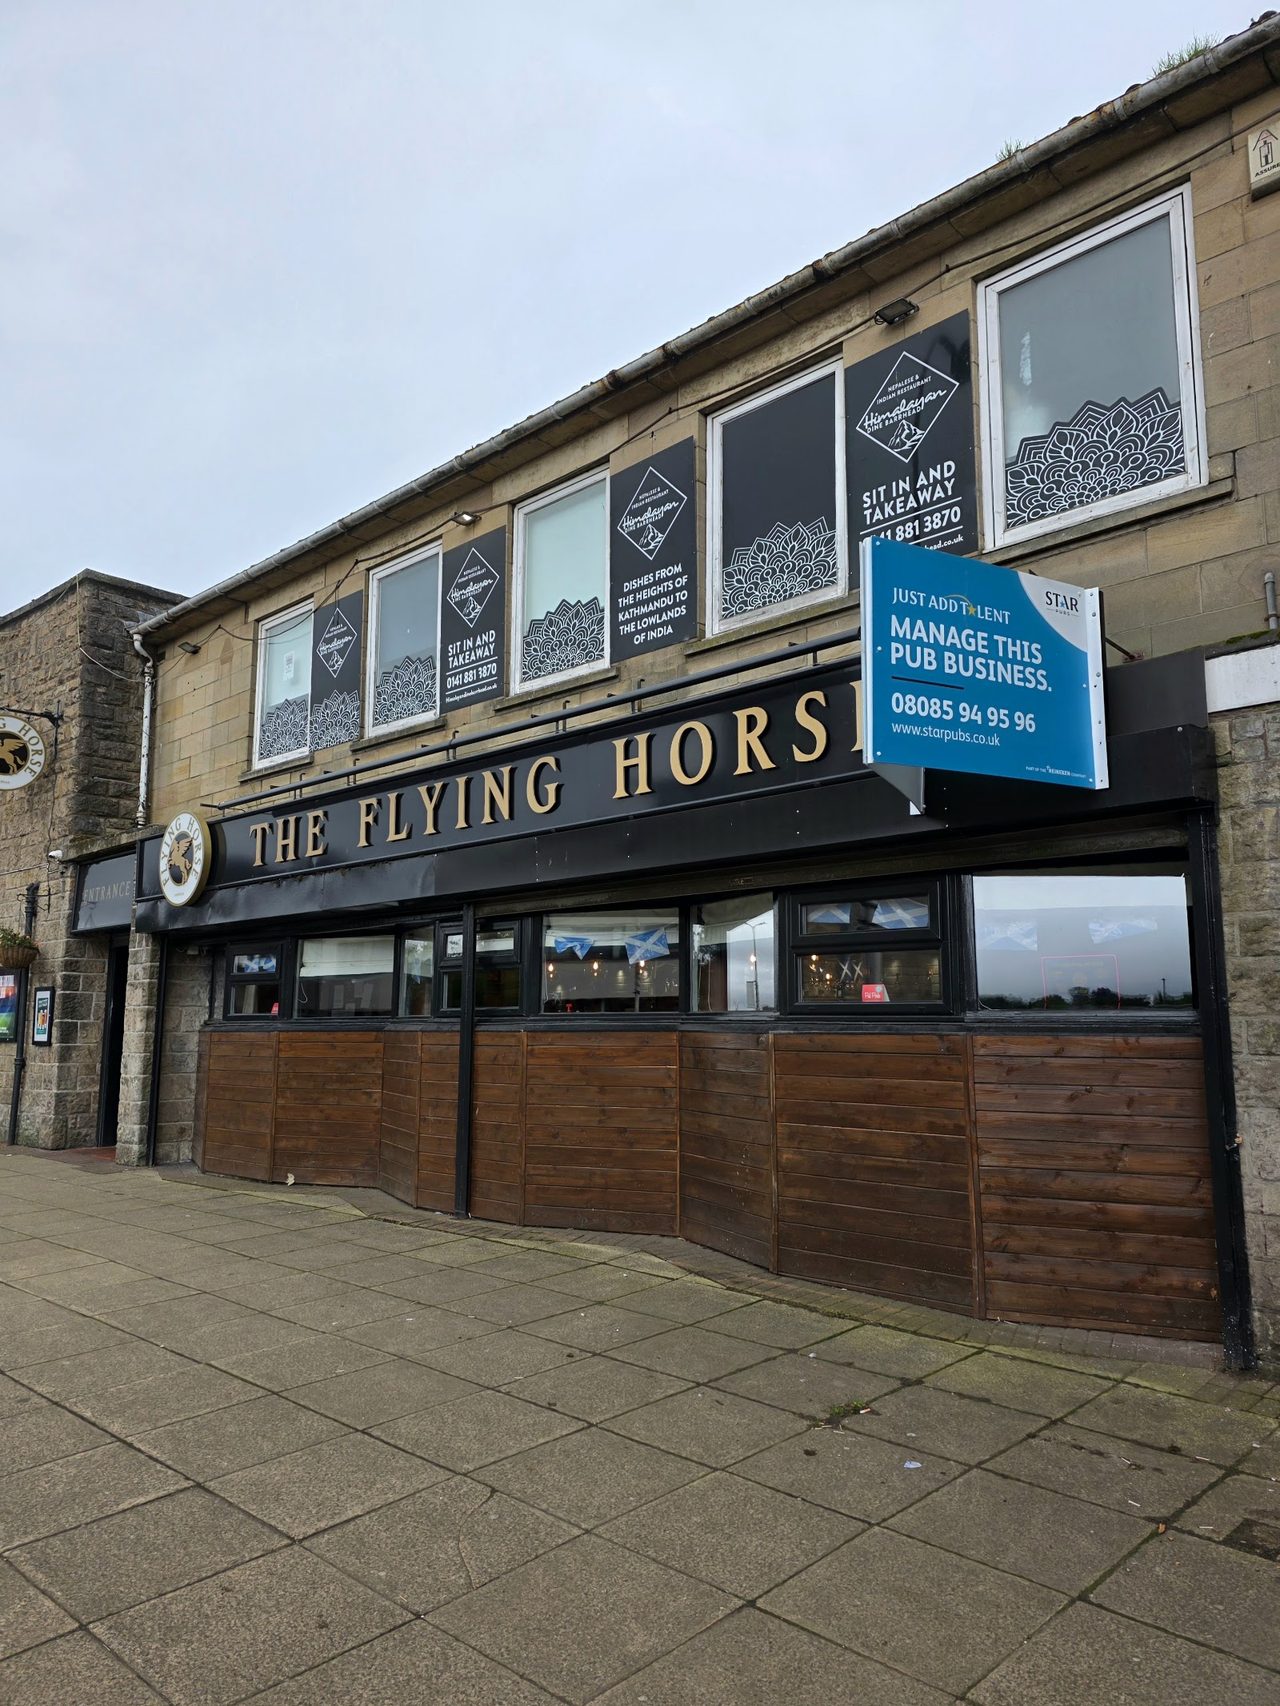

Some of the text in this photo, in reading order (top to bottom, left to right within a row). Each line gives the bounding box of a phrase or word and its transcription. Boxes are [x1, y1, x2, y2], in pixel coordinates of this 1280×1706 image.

[876, 375, 932, 405] INDIAN RESTAURANT
[887, 375, 914, 392] NEPALESE
[863, 389, 947, 430] Himalayan
[866, 405, 921, 434] DINE BARRHEAD
[862, 460, 956, 508] SIT IN AND
[622, 501, 679, 530] Himalayan
[863, 477, 956, 526] TAKEAWAY
[895, 519, 920, 542] 881
[923, 506, 961, 533] 3870
[618, 574, 688, 608] THE HEIGHTS OF
[623, 562, 682, 593] DISHES FROM
[618, 590, 688, 622] KATHMANDU TO
[892, 587, 926, 607] JUST
[928, 595, 958, 612] ADD
[1045, 590, 1079, 613] STAR
[619, 605, 687, 636] THE LOWLANDS
[633, 624, 674, 645] OF INDIA
[448, 629, 496, 656] SIT IN AND
[890, 614, 1042, 665] MANAGE THIS
[448, 642, 495, 669] TAKEAWAY
[890, 641, 1053, 692] PUB BUSINESS.
[446, 662, 497, 689] 0141 881 3870
[891, 692, 1036, 733] 08085 94 95 96
[891, 722, 1001, 747] www.starpubs.co.uk
[18, 724, 43, 778] HORSE
[249, 809, 329, 868] THE
[356, 755, 564, 848] FLYING
[160, 816, 202, 887] FLYING HORSE
[84, 880, 131, 902] ENTRANCE
